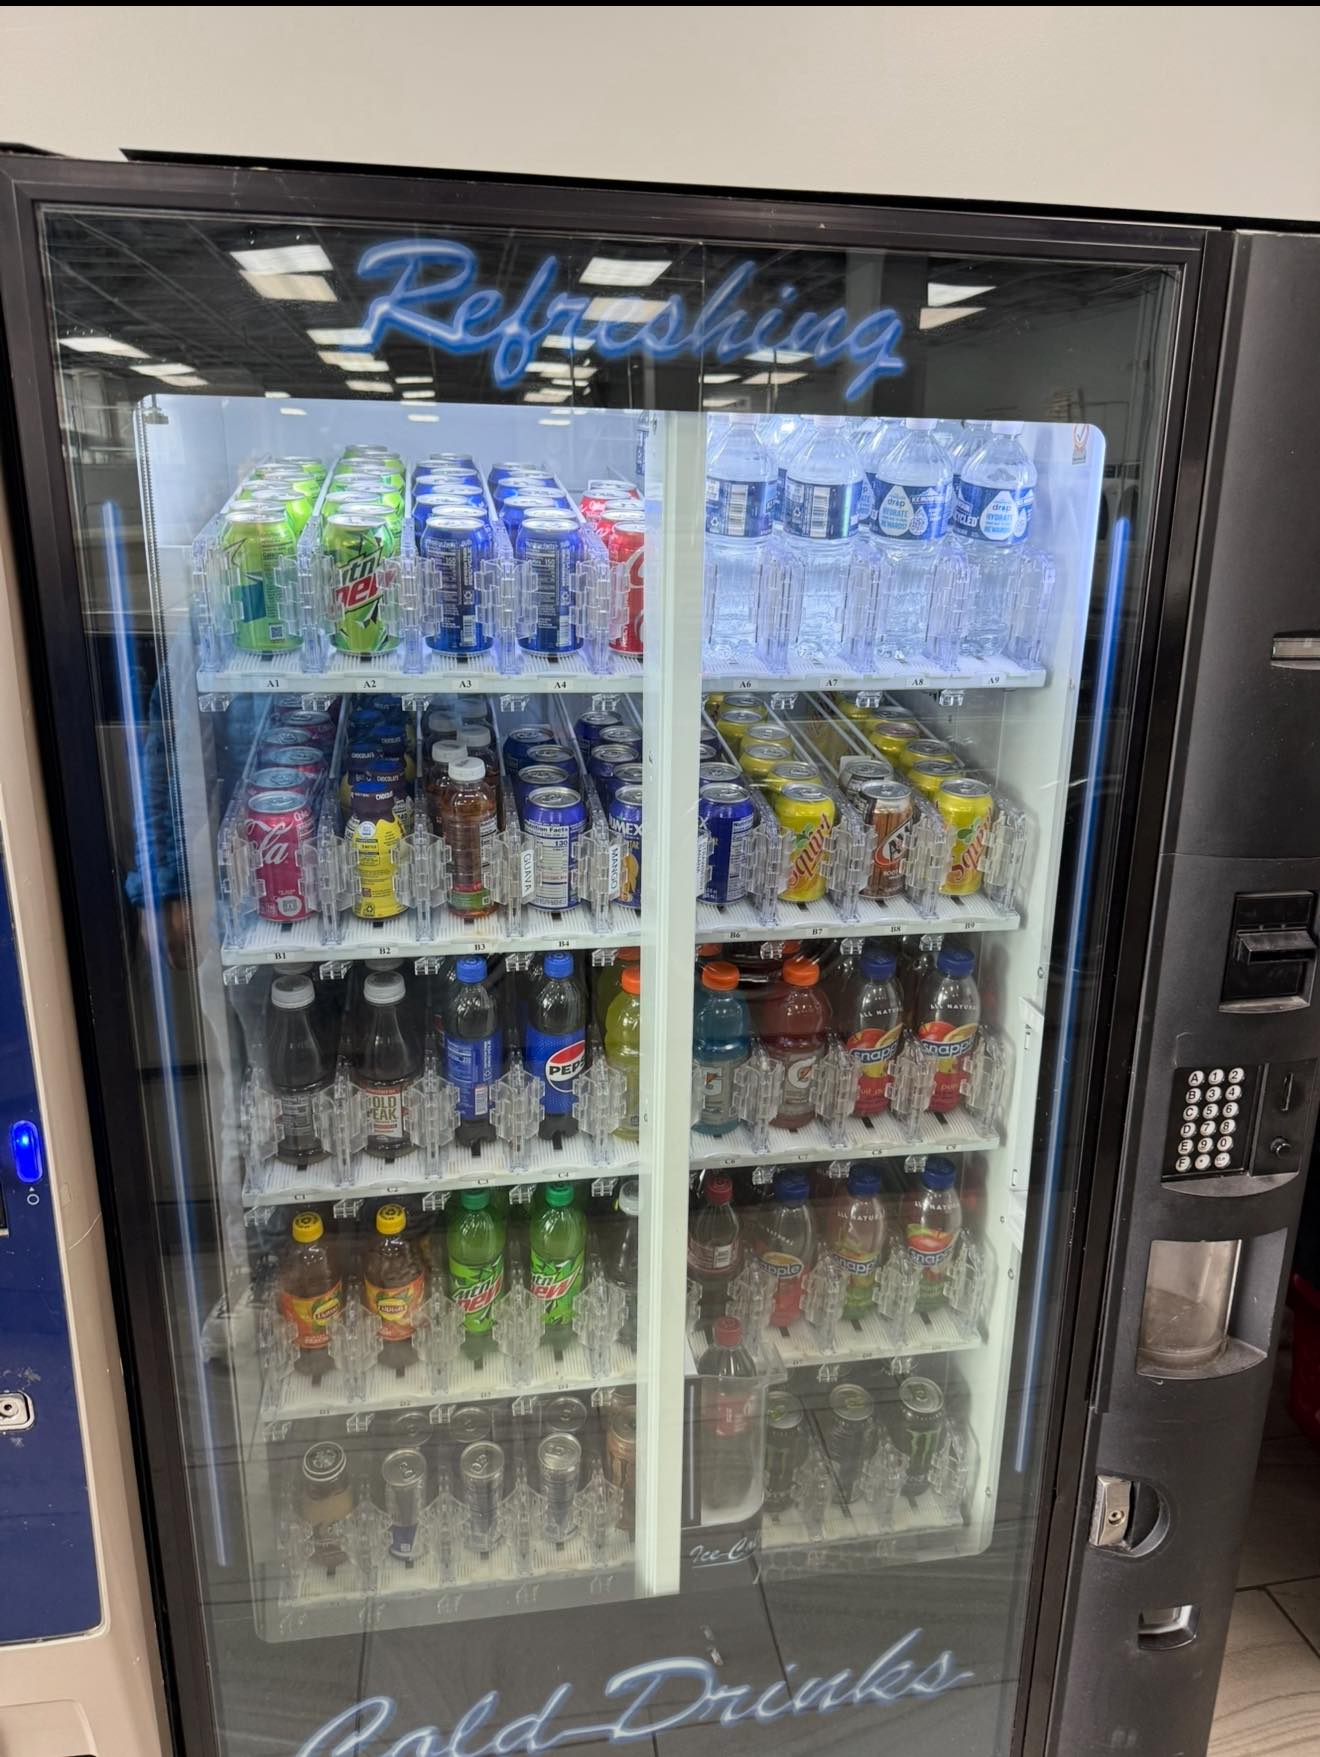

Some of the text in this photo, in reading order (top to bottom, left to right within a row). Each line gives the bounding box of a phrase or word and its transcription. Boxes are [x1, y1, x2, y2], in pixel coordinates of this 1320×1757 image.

[345, 239, 904, 399] Refreshing
[267, 680, 279, 688] A1
[363, 680, 376, 688] A2
[459, 680, 472, 688] A3
[555, 681, 567, 689] A4
[739, 680, 751, 688] A6
[826, 679, 839, 687] A7
[523, 853, 532, 891] GUAVA
[730, 931, 741, 939] B6
[474, 943, 485, 951] B3
[558, 940, 569, 948] B4
[379, 947, 391, 955] B2
[275, 952, 286, 960] B1
[1190, 1073, 1199, 1083] A
[1231, 1070, 1238, 1080] 2
[1188, 1087, 1235, 1100] B 3 4
[1185, 1104, 1232, 1117] C 5 6
[1183, 1121, 1229, 1134] D 7 8
[1181, 1138, 1227, 1151] E 9 0
[1178, 1158, 1186, 1168] F
[604, 1627, 973, 1743] Drinks
